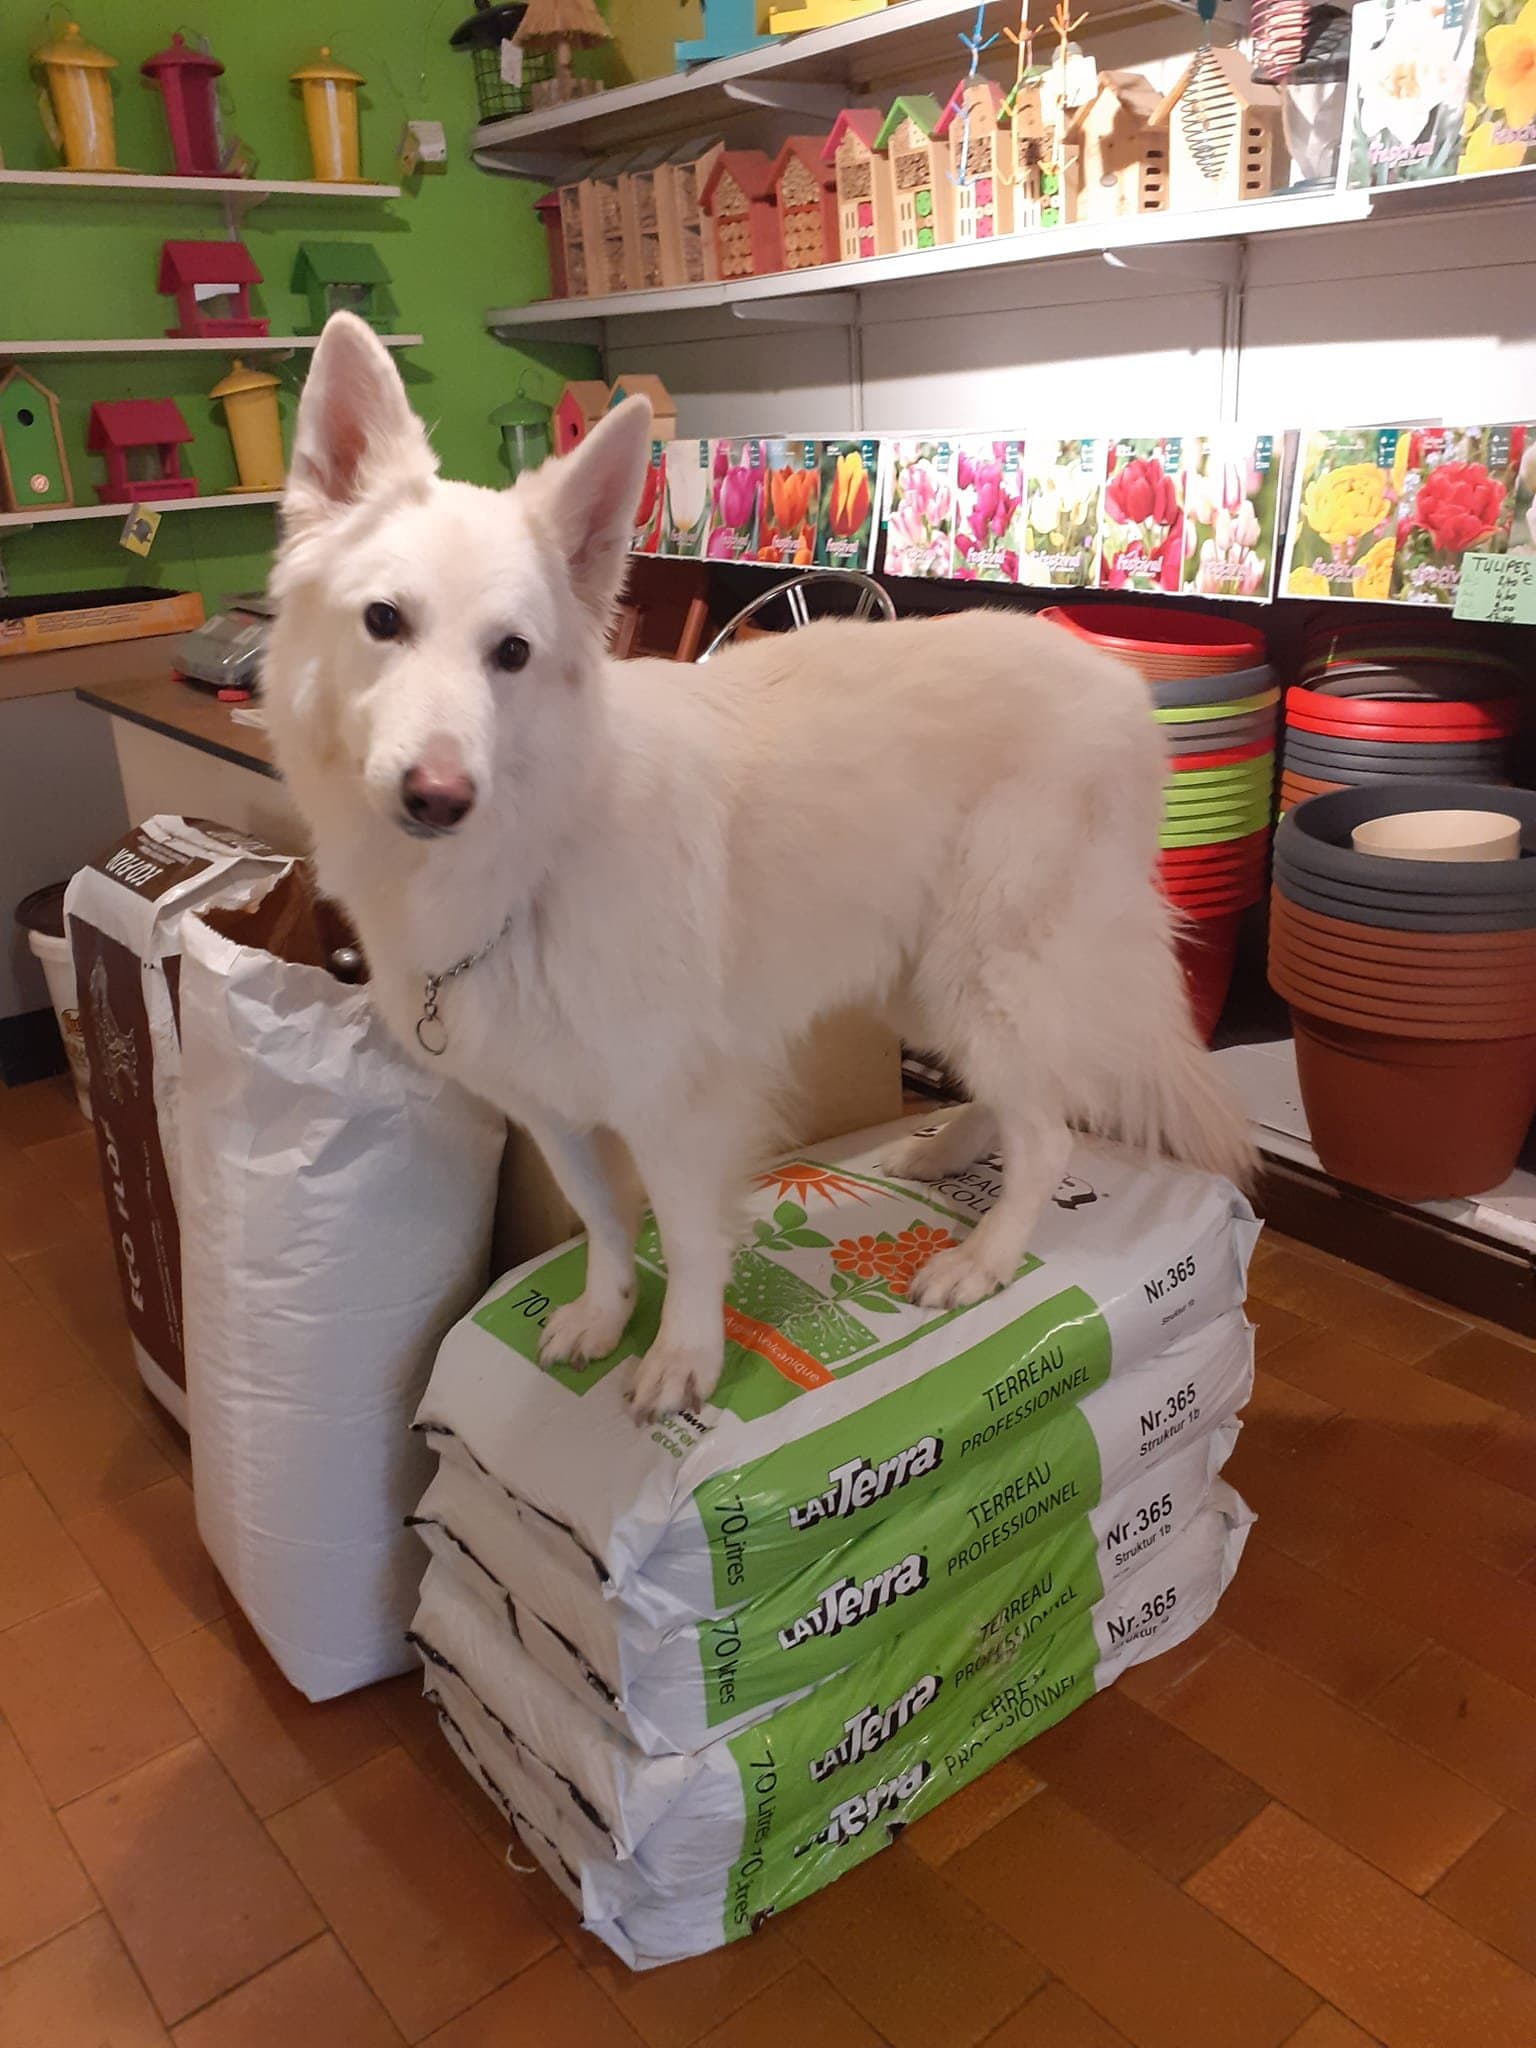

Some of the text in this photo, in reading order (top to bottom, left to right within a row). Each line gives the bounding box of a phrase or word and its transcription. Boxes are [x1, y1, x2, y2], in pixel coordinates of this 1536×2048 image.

[511, 1290, 549, 1318] 70
[1144, 1255, 1196, 1305] Nr.365
[982, 1345, 1065, 1412] TERREAU
[960, 1365, 1091, 1458] PROFESSIONNEL
[1140, 1382, 1197, 1437] Nr.365
[1139, 1419, 1185, 1457] Struktur
[966, 1461, 1052, 1530] TERREAU
[1107, 1492, 1174, 1551] Nr.365
[947, 1481, 1080, 1576] PROFESSIONNEL
[1114, 1532, 1158, 1567] Struktur
[711, 1618, 742, 1658] 70
[1106, 1585, 1177, 1645] Nr.365
[749, 1749, 778, 1794] 70
